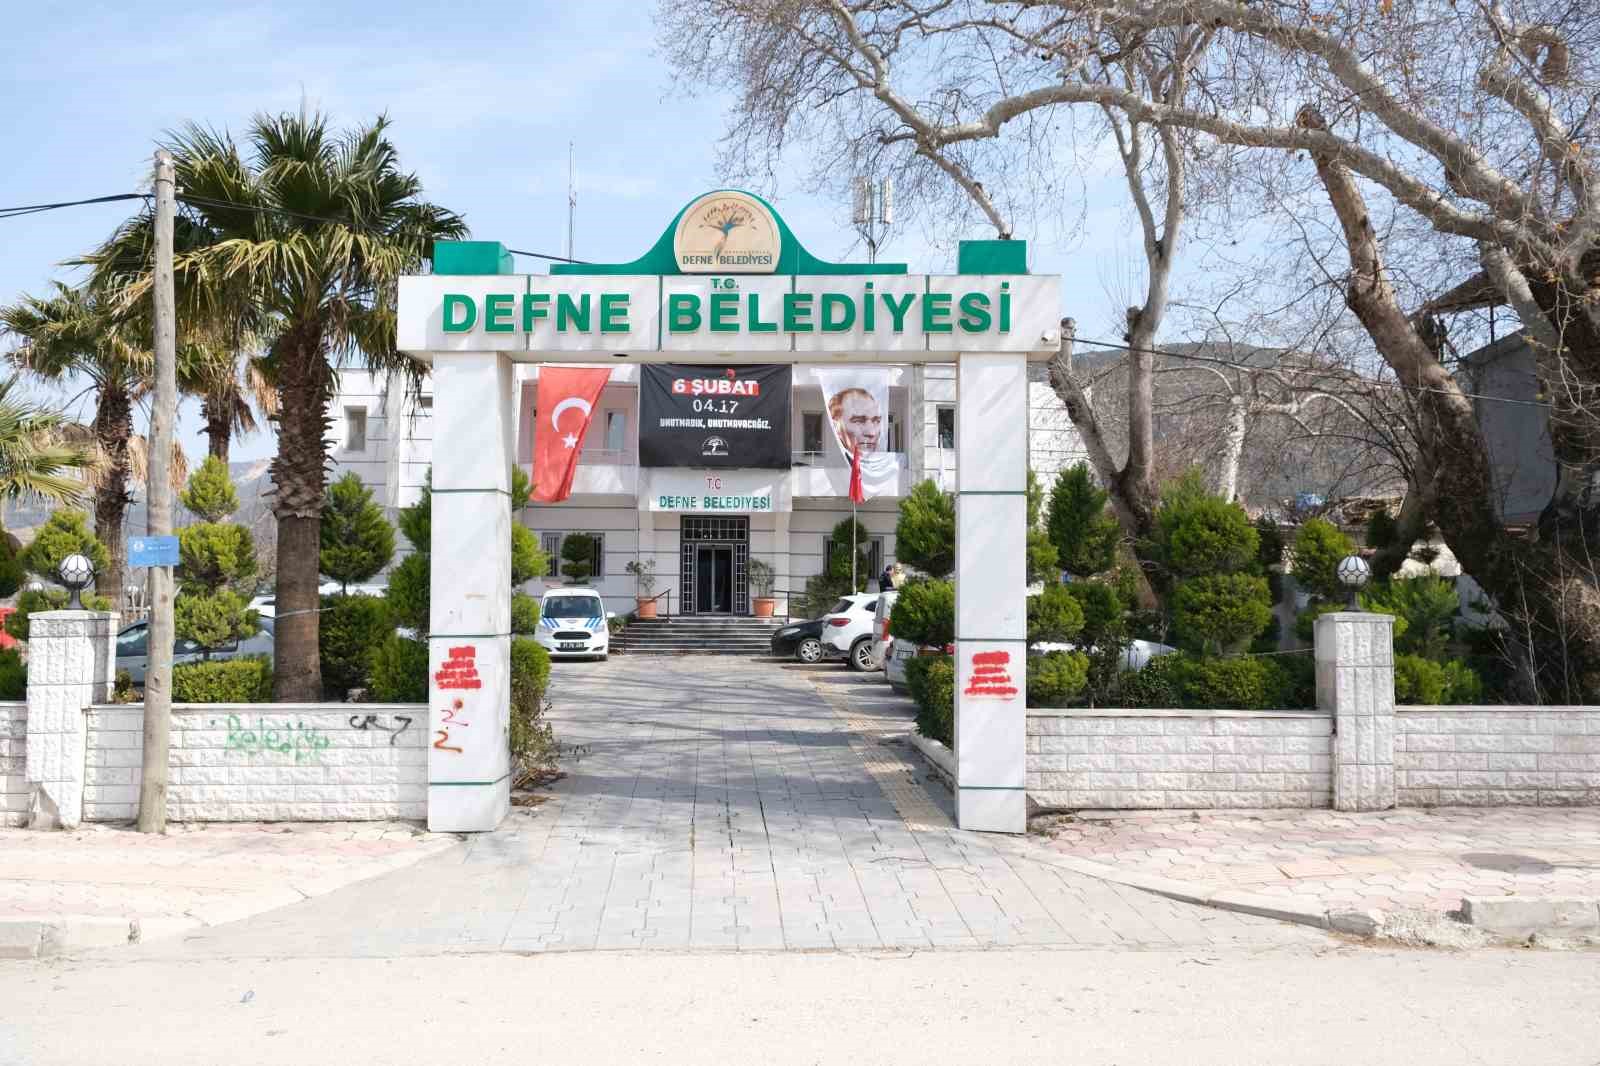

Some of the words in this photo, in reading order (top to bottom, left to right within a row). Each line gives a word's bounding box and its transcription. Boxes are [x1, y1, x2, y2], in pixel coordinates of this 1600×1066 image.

[682, 255, 713, 265] DEFNE
[442, 293, 631, 333] DEFNE
[668, 281, 1012, 334] BELEDİYESİ
[673, 378, 686, 394] 6
[691, 378, 759, 396] ŞUBAT
[692, 399, 739, 414] 04.17
[659, 495, 697, 508] DEFNE
